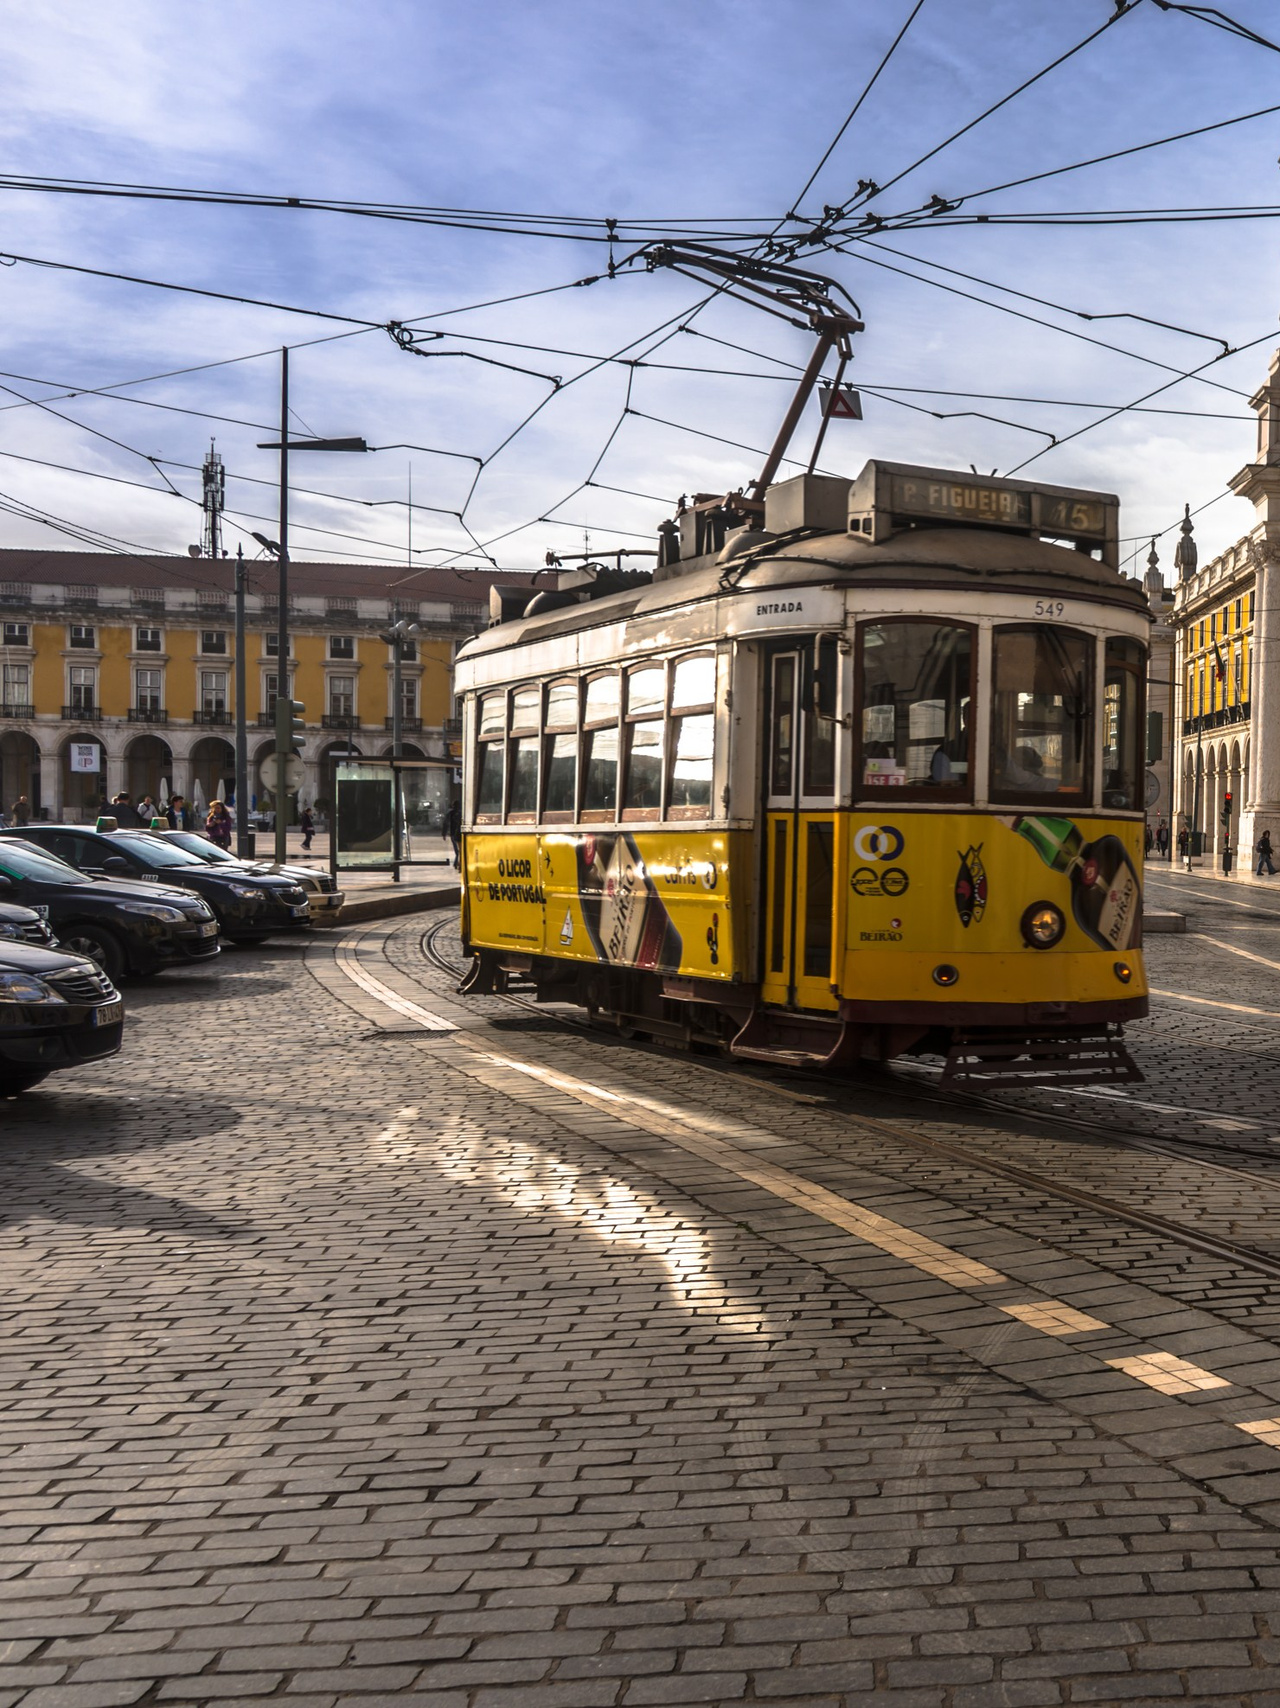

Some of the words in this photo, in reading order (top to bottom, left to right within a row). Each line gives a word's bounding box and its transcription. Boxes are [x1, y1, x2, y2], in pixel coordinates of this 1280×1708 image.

[757, 601, 803, 616] ENTRADA
[1034, 601, 1064, 617] 549
[498, 859, 505, 877] O
[507, 859, 532, 878] LICOR
[488, 883, 500, 901] DE
[501, 884, 547, 904] PORTUGAL
